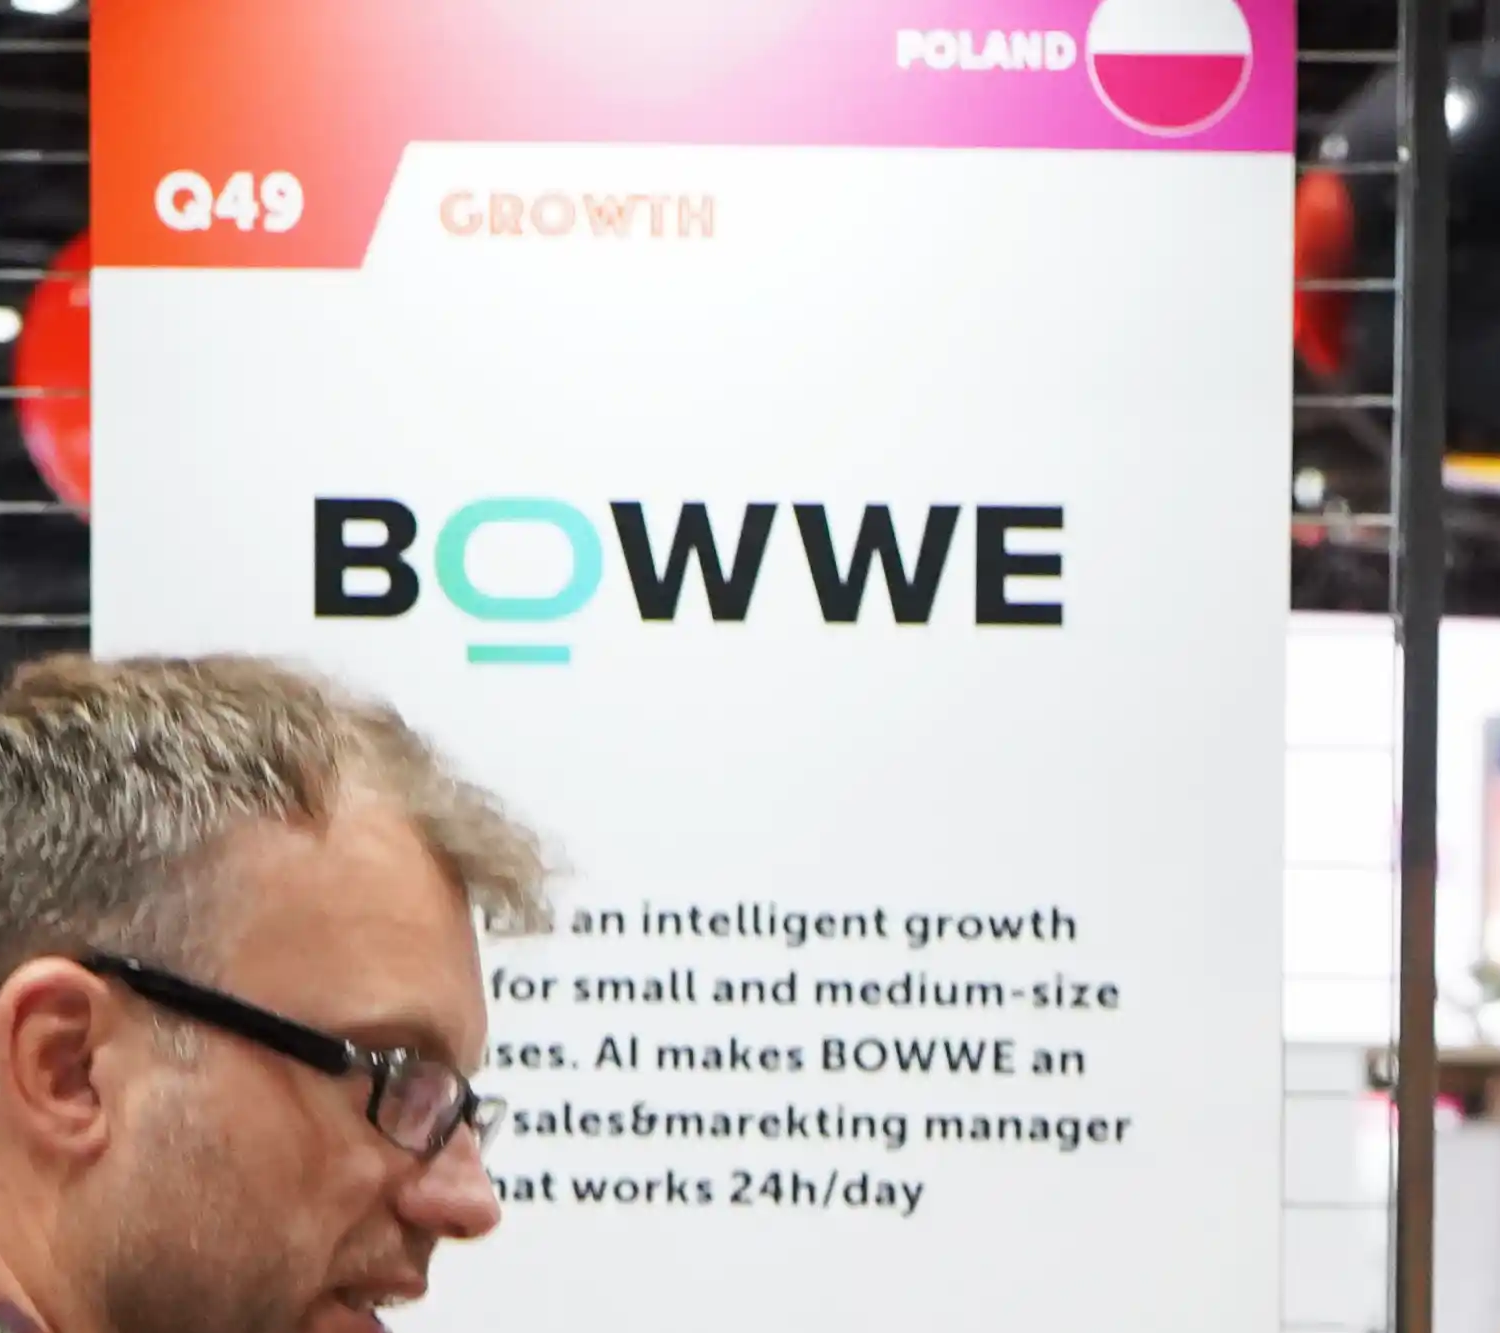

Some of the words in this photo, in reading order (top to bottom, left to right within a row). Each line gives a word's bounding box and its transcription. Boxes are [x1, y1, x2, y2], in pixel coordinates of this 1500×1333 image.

[896, 30, 1077, 72] POLAND
[154, 169, 306, 234] Q49
[438, 189, 716, 239] GROWTH
[313, 496, 1065, 663] BOWWE
[570, 911, 625, 935] an
[642, 903, 887, 947] intelligent
[904, 906, 1076, 948] growth
[491, 967, 557, 1001] for
[573, 969, 696, 1002] small
[712, 971, 797, 1004] and
[815, 972, 1119, 1009] medium-size
[594, 1035, 638, 1069] AI
[657, 1036, 804, 1071] makes
[822, 1038, 1014, 1074] BOWWE
[1031, 1050, 1085, 1075] an
[513, 1101, 908, 1149] sales&marekting
[925, 1116, 1130, 1152] manager
[486, 1168, 555, 1202] hat
[571, 1169, 713, 1204] works
[729, 1170, 924, 1217] 24h/day
